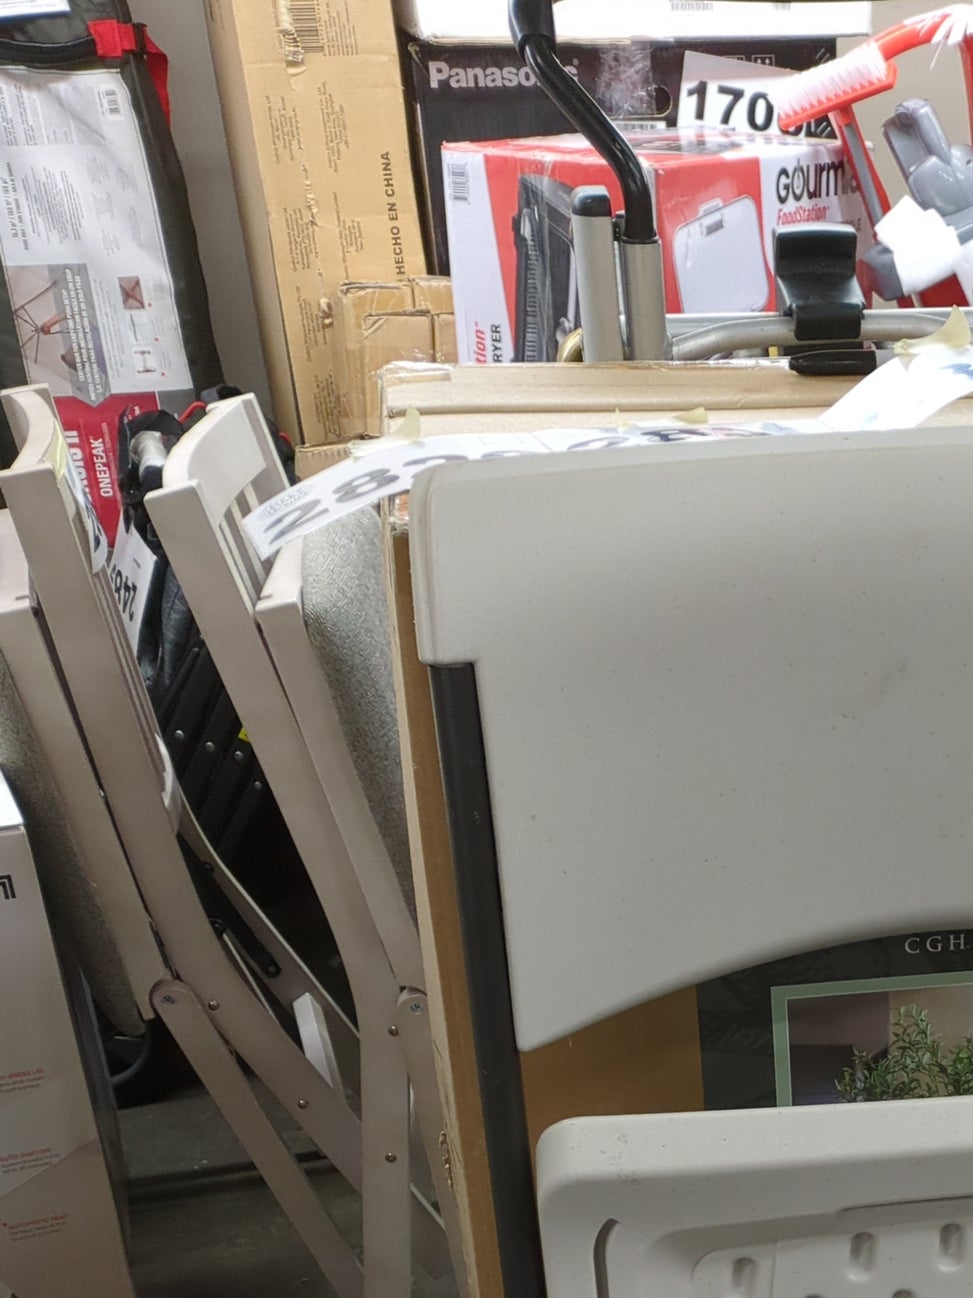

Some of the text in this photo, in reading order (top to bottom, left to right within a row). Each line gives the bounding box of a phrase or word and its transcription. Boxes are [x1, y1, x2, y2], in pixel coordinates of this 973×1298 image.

[428, 61, 579, 88] Panaso
[380, 152, 406, 275] HECHO EN CHINA
[91, 438, 113, 498] ONEPEAK
[904, 933, 967, 954] CGH
